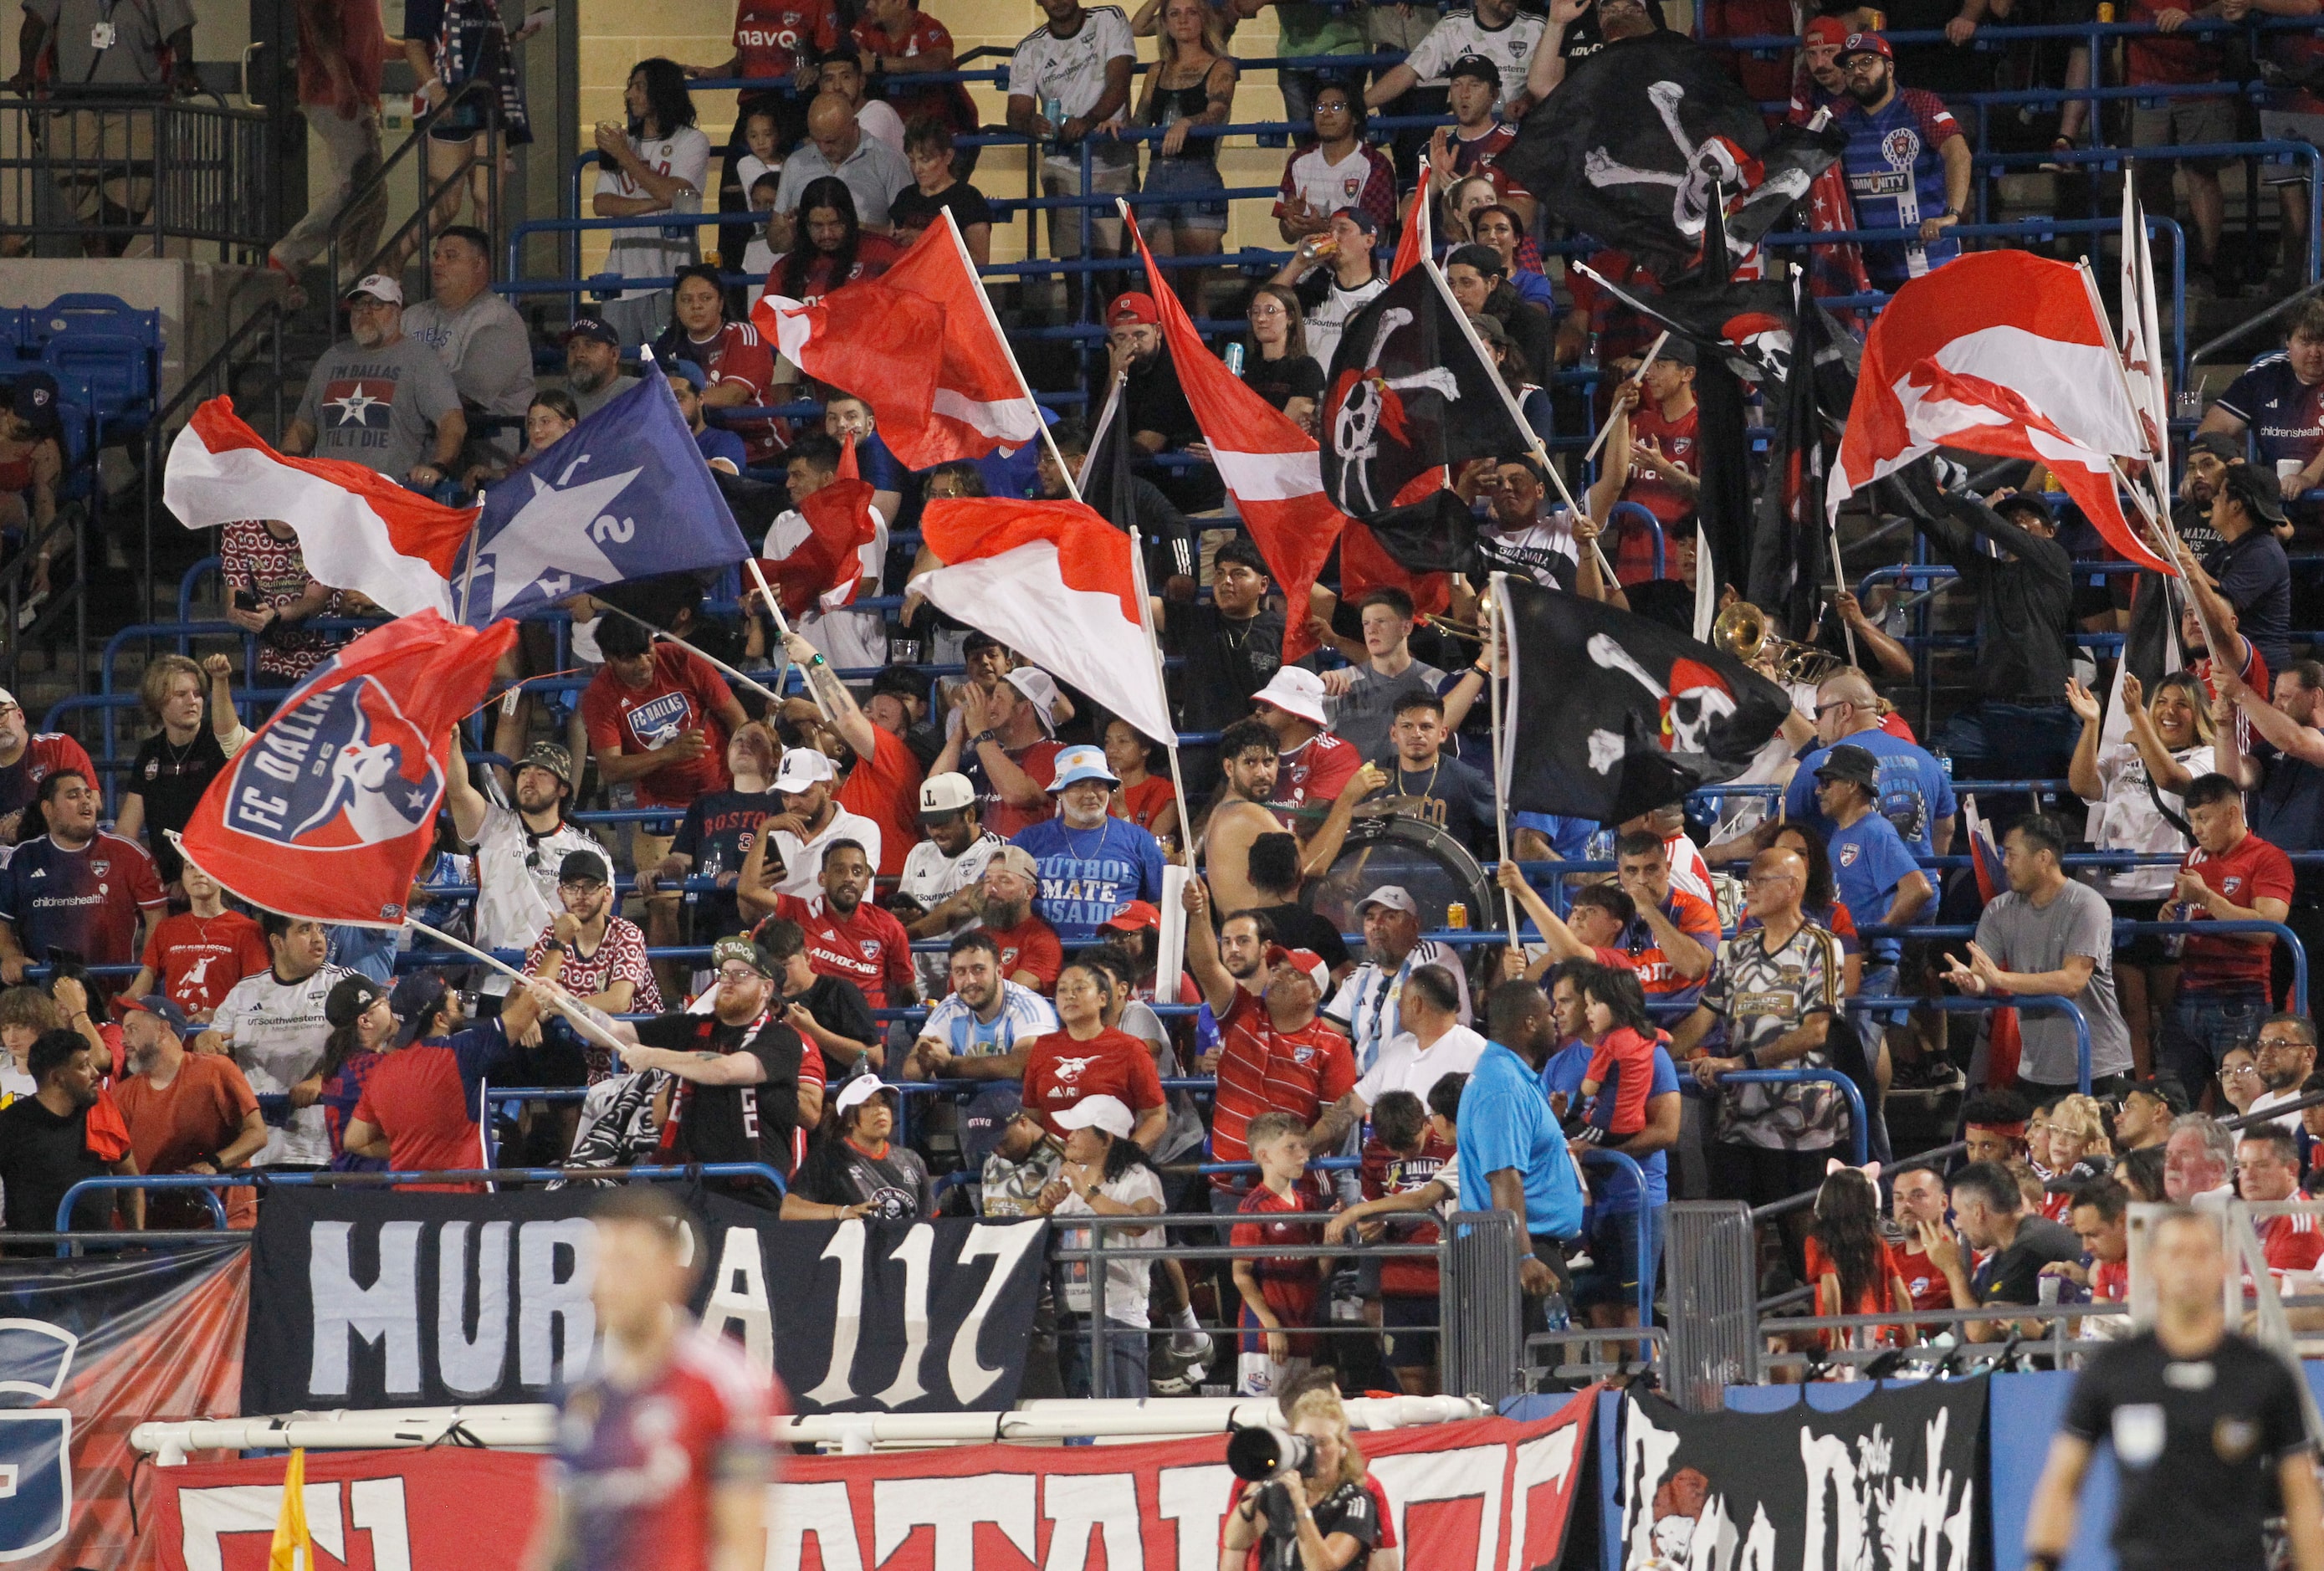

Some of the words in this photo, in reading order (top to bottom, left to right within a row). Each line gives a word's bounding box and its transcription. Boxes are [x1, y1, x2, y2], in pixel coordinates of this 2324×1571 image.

[361, 430, 391, 449] DIE
[632, 710, 648, 729] FC
[646, 696, 684, 722] DALLAS
[254, 683, 337, 784] DALLA
[238, 762, 289, 833] FC
[704, 811, 772, 837] BOSTO
[1041, 878, 1119, 904] MATE
[207, 944, 233, 954] SOCCER
[715, 942, 755, 963] MTADOR
[811, 947, 878, 975] ADVOCARE
[802, 1216, 1047, 1407] 117
